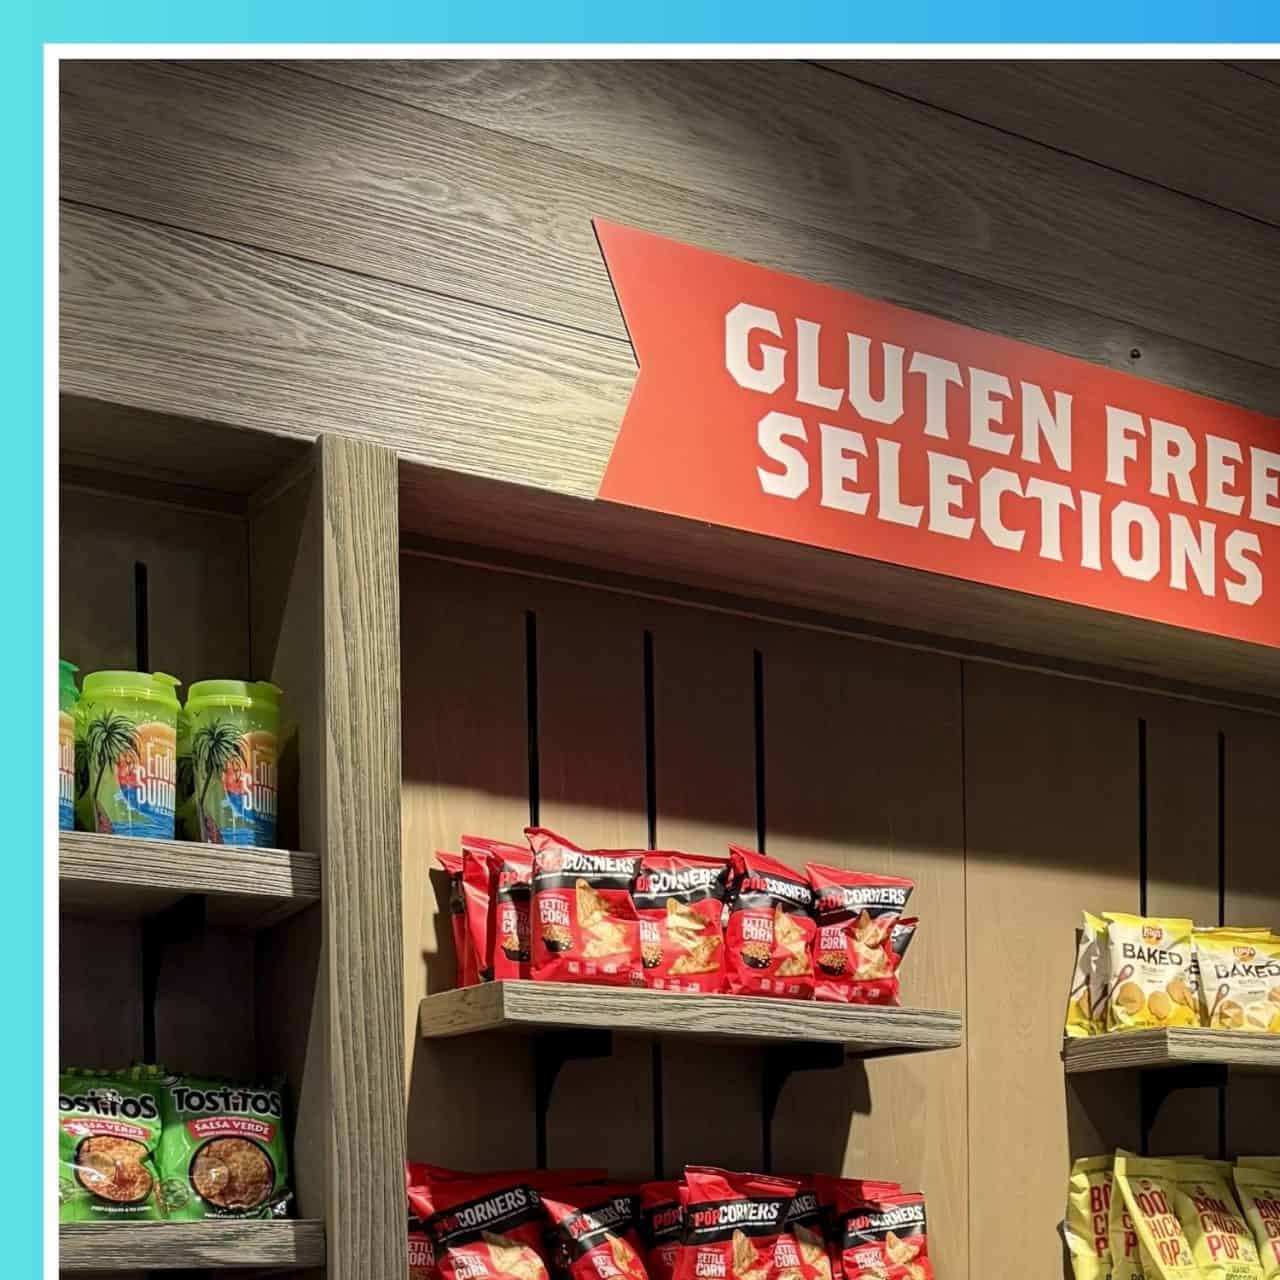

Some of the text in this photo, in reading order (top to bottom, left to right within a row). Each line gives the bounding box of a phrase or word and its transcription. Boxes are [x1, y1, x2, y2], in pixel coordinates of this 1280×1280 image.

[725, 301, 1073, 472] GLUTEN
[756, 410, 1264, 605] SELECTIONS
[541, 910, 570, 926] CORN
[743, 928, 774, 943] CORN
[820, 934, 848, 950] CORN
[1122, 942, 1184, 966] BAKED
[194, 1119, 270, 1136] SALSA VERDE
[407, 1241, 433, 1253] ETTLE
[1205, 1234, 1240, 1262] POP
[407, 1252, 435, 1266] ORN
[696, 1253, 725, 1265] KETTLE
[695, 1263, 726, 1277] CORN
